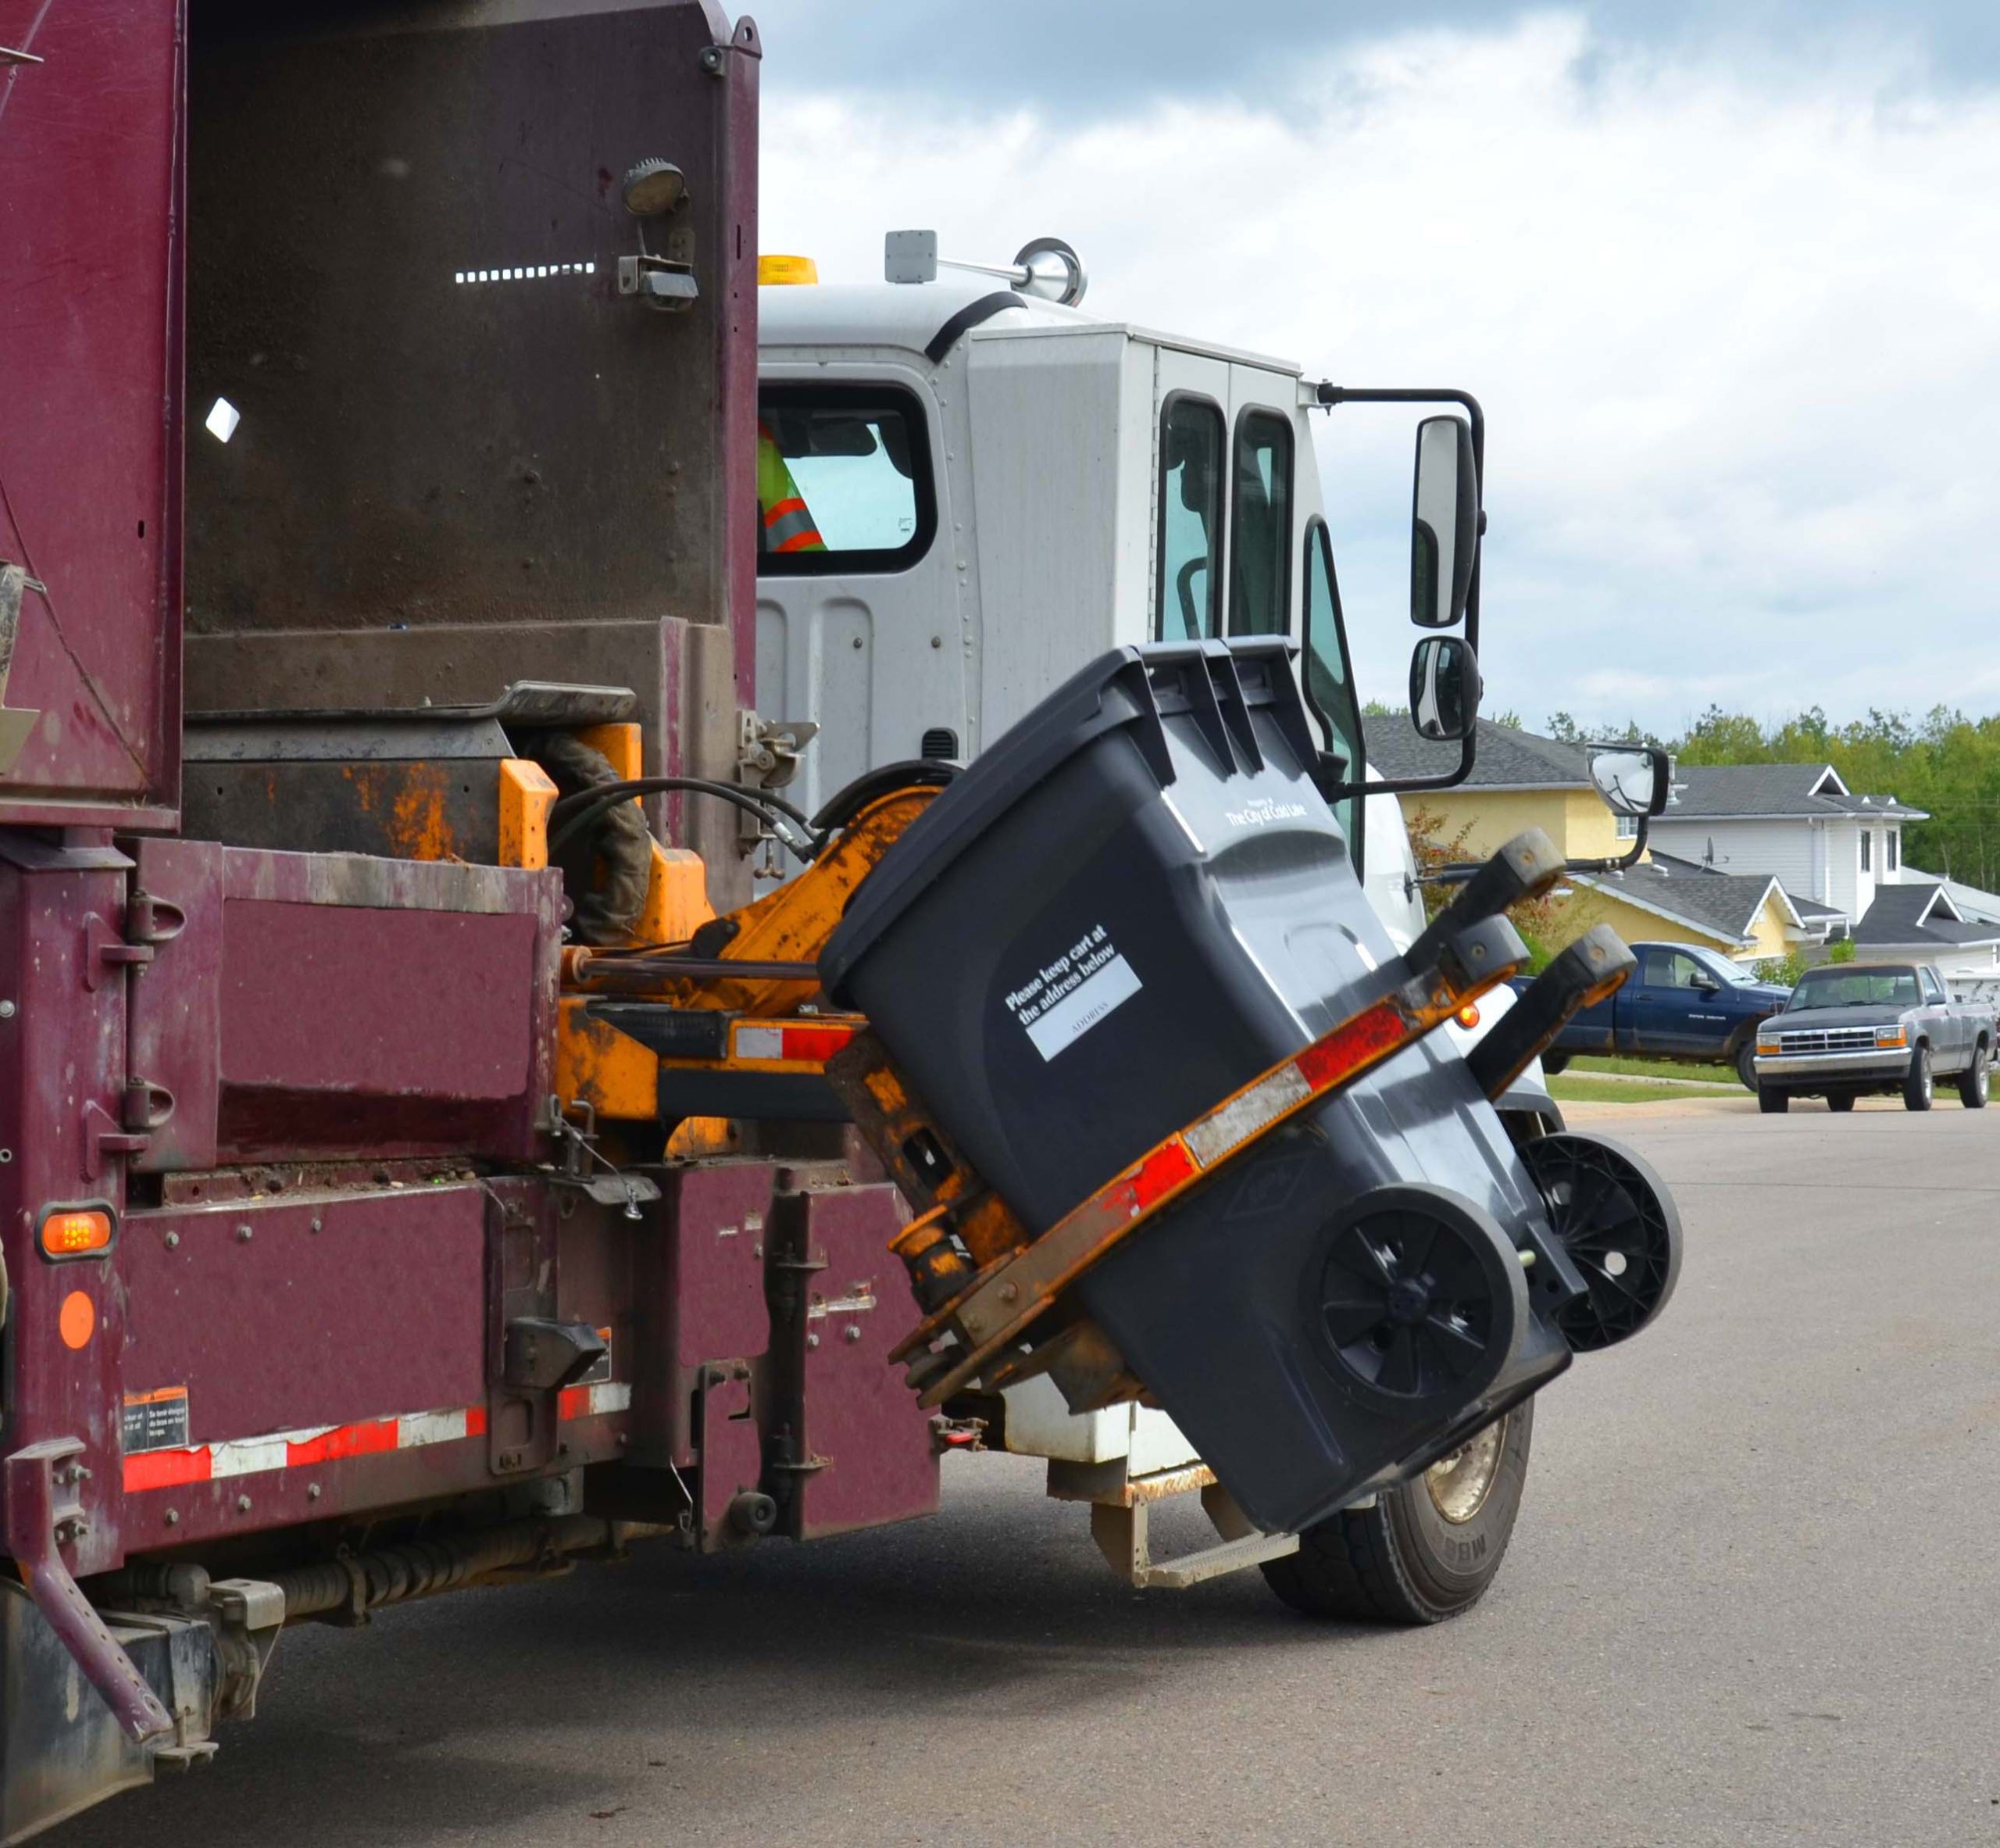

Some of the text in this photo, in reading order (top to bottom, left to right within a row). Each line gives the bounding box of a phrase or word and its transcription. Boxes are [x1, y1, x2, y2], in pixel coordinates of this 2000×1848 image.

[1225, 802, 1308, 827] The City of Cold Lake
[1005, 924, 1108, 1012] Please keep cart at
[1018, 942, 1116, 1025] the address below
[1071, 1001, 1109, 1033] ADDRESS
